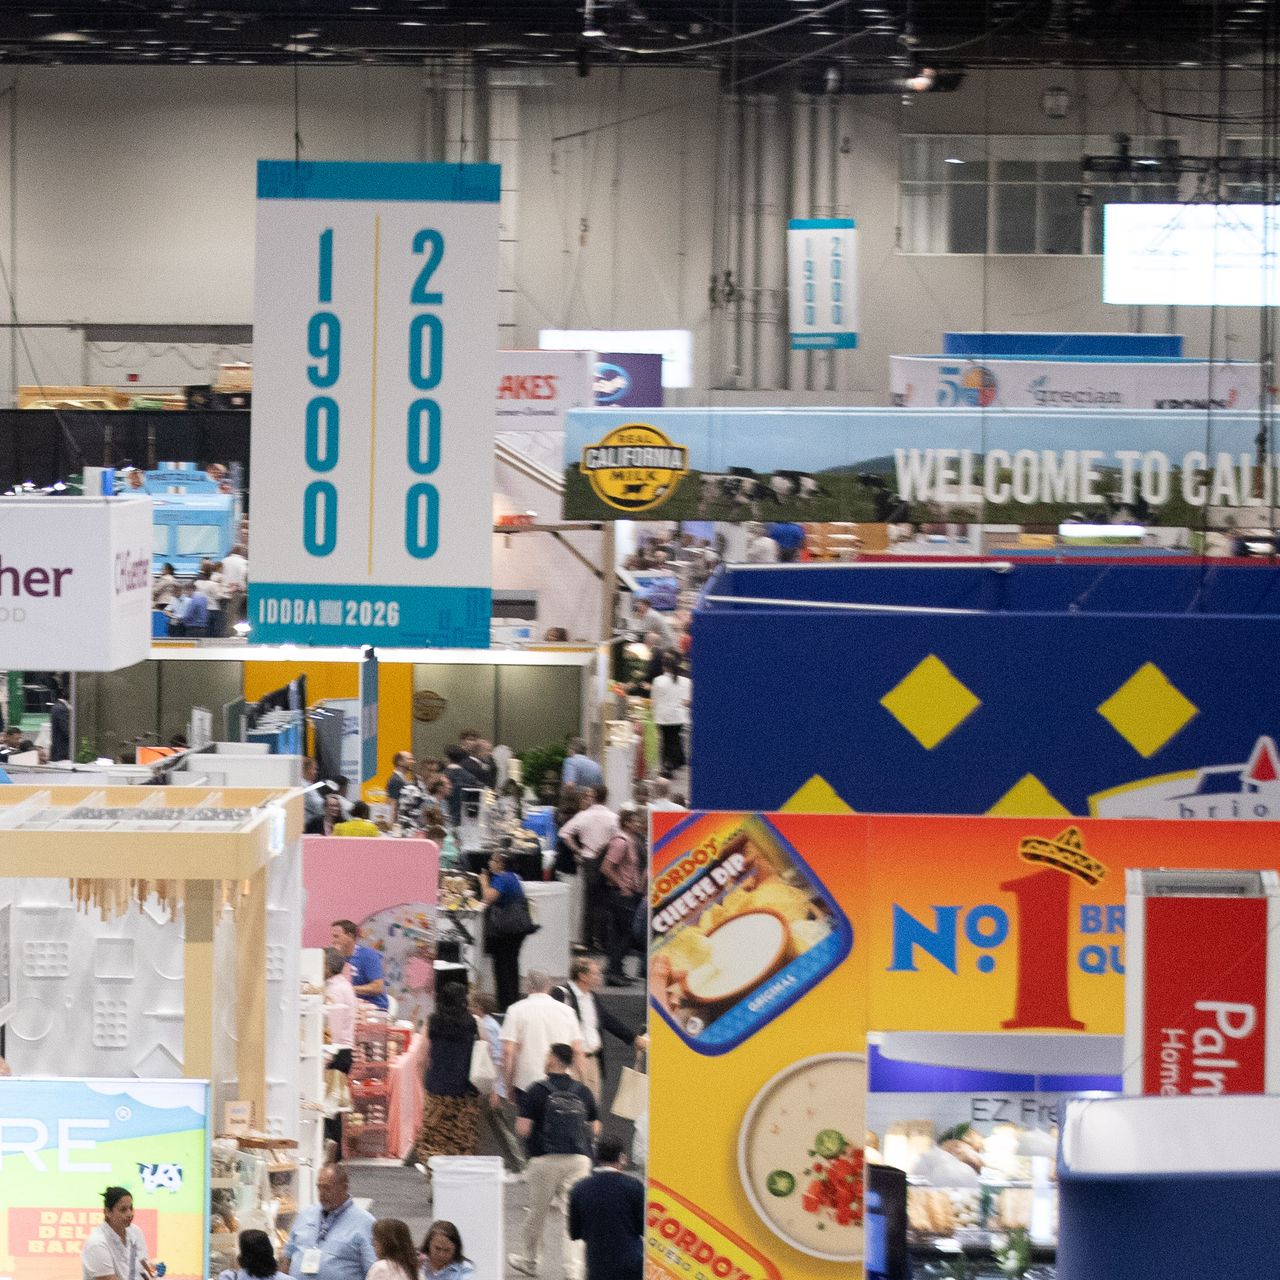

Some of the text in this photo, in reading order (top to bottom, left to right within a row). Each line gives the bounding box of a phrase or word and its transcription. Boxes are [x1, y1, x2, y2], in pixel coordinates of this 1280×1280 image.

[302, 228, 343, 557] 1900
[404, 228, 445, 560] 2000
[496, 374, 559, 398] AKES
[586, 446, 686, 472] CALIFORNIA
[894, 447, 1105, 504] WELCOME
[1115, 450, 1170, 505] TO
[258, 597, 401, 627] IDDBA 2026
[651, 850, 747, 934] CHEESE DIP
[971, 1097, 1010, 1122] EZ
[39, 1211, 104, 1225] DAIR
[38, 1225, 91, 1239] DEL
[28, 1239, 83, 1254] BAK
